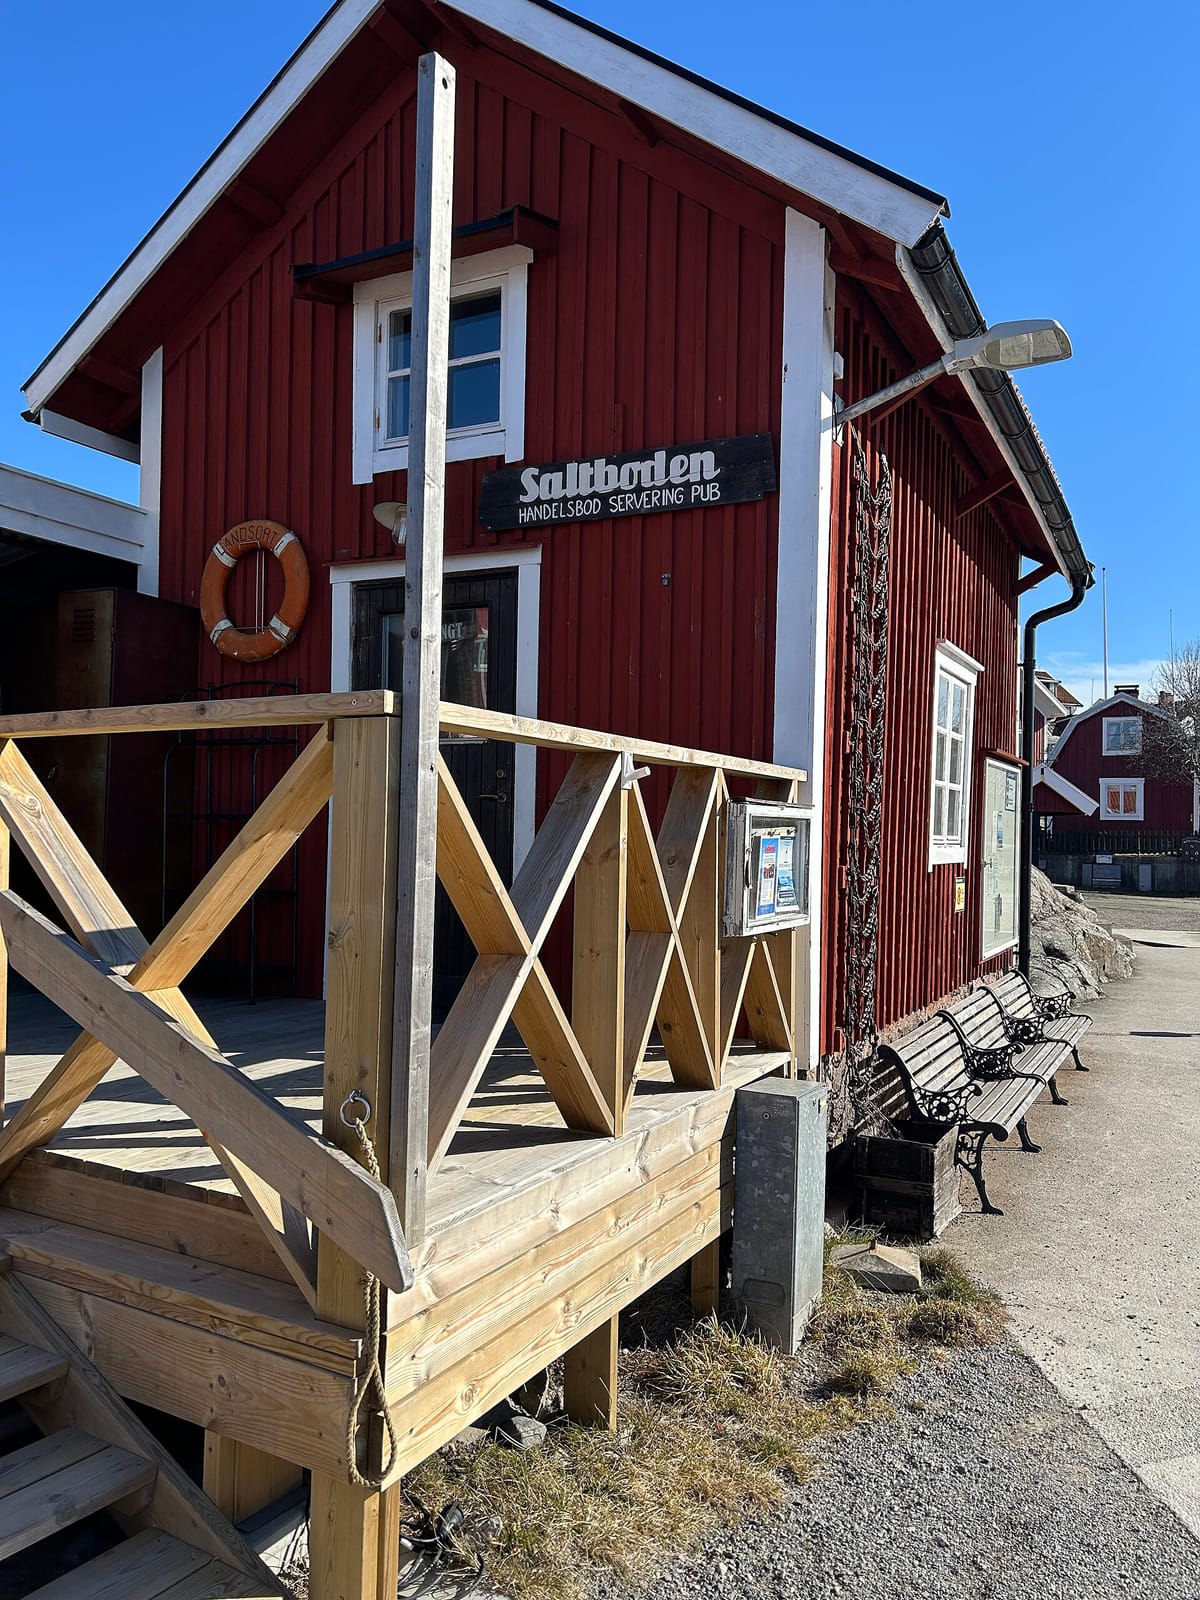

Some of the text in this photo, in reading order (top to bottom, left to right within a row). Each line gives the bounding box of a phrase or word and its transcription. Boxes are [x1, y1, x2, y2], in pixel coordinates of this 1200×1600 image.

[519, 450, 721, 502] Saltboden
[518, 482, 721, 524] HANDELSBOD SERVERING PUB
[441, 622, 463, 641] NGT
